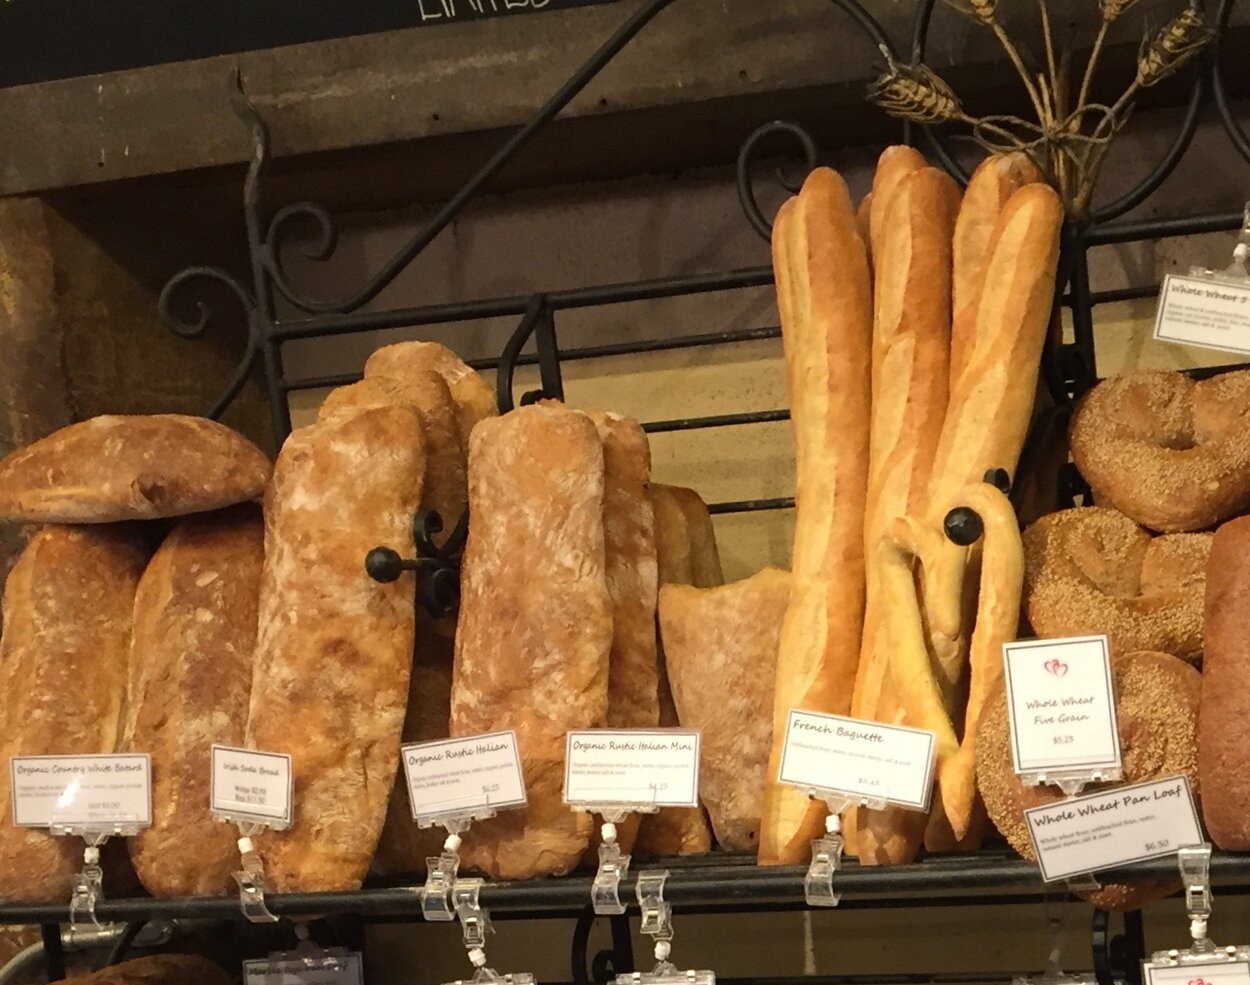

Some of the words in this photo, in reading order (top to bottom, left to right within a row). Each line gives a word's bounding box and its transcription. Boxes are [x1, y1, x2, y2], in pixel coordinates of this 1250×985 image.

[1171, 284, 1204, 296] Whole
[1205, 289, 1238, 302] Wheat
[1025, 699, 1059, 710] Whole
[1060, 695, 1095, 706] Wheat
[1033, 715, 1056, 725] Five
[1057, 713, 1090, 723] Grain
[792, 719, 833, 734] French
[835, 726, 884, 743] Baguette
[408, 753, 444, 766] Organic
[444, 747, 475, 760] Rustic
[475, 743, 509, 755] Italian
[572, 740, 607, 753] Organic
[608, 740, 637, 751] Rustic
[637, 741, 668, 751] Italian
[670, 740, 694, 751] Mini
[16, 764, 49, 776] Organic
[52, 764, 85, 774] Country
[1033, 810, 1076, 827] Whole
[1076, 799, 1121, 817] Wheat
[1122, 795, 1151, 807] Pan
[1153, 784, 1181, 801] Loaf
